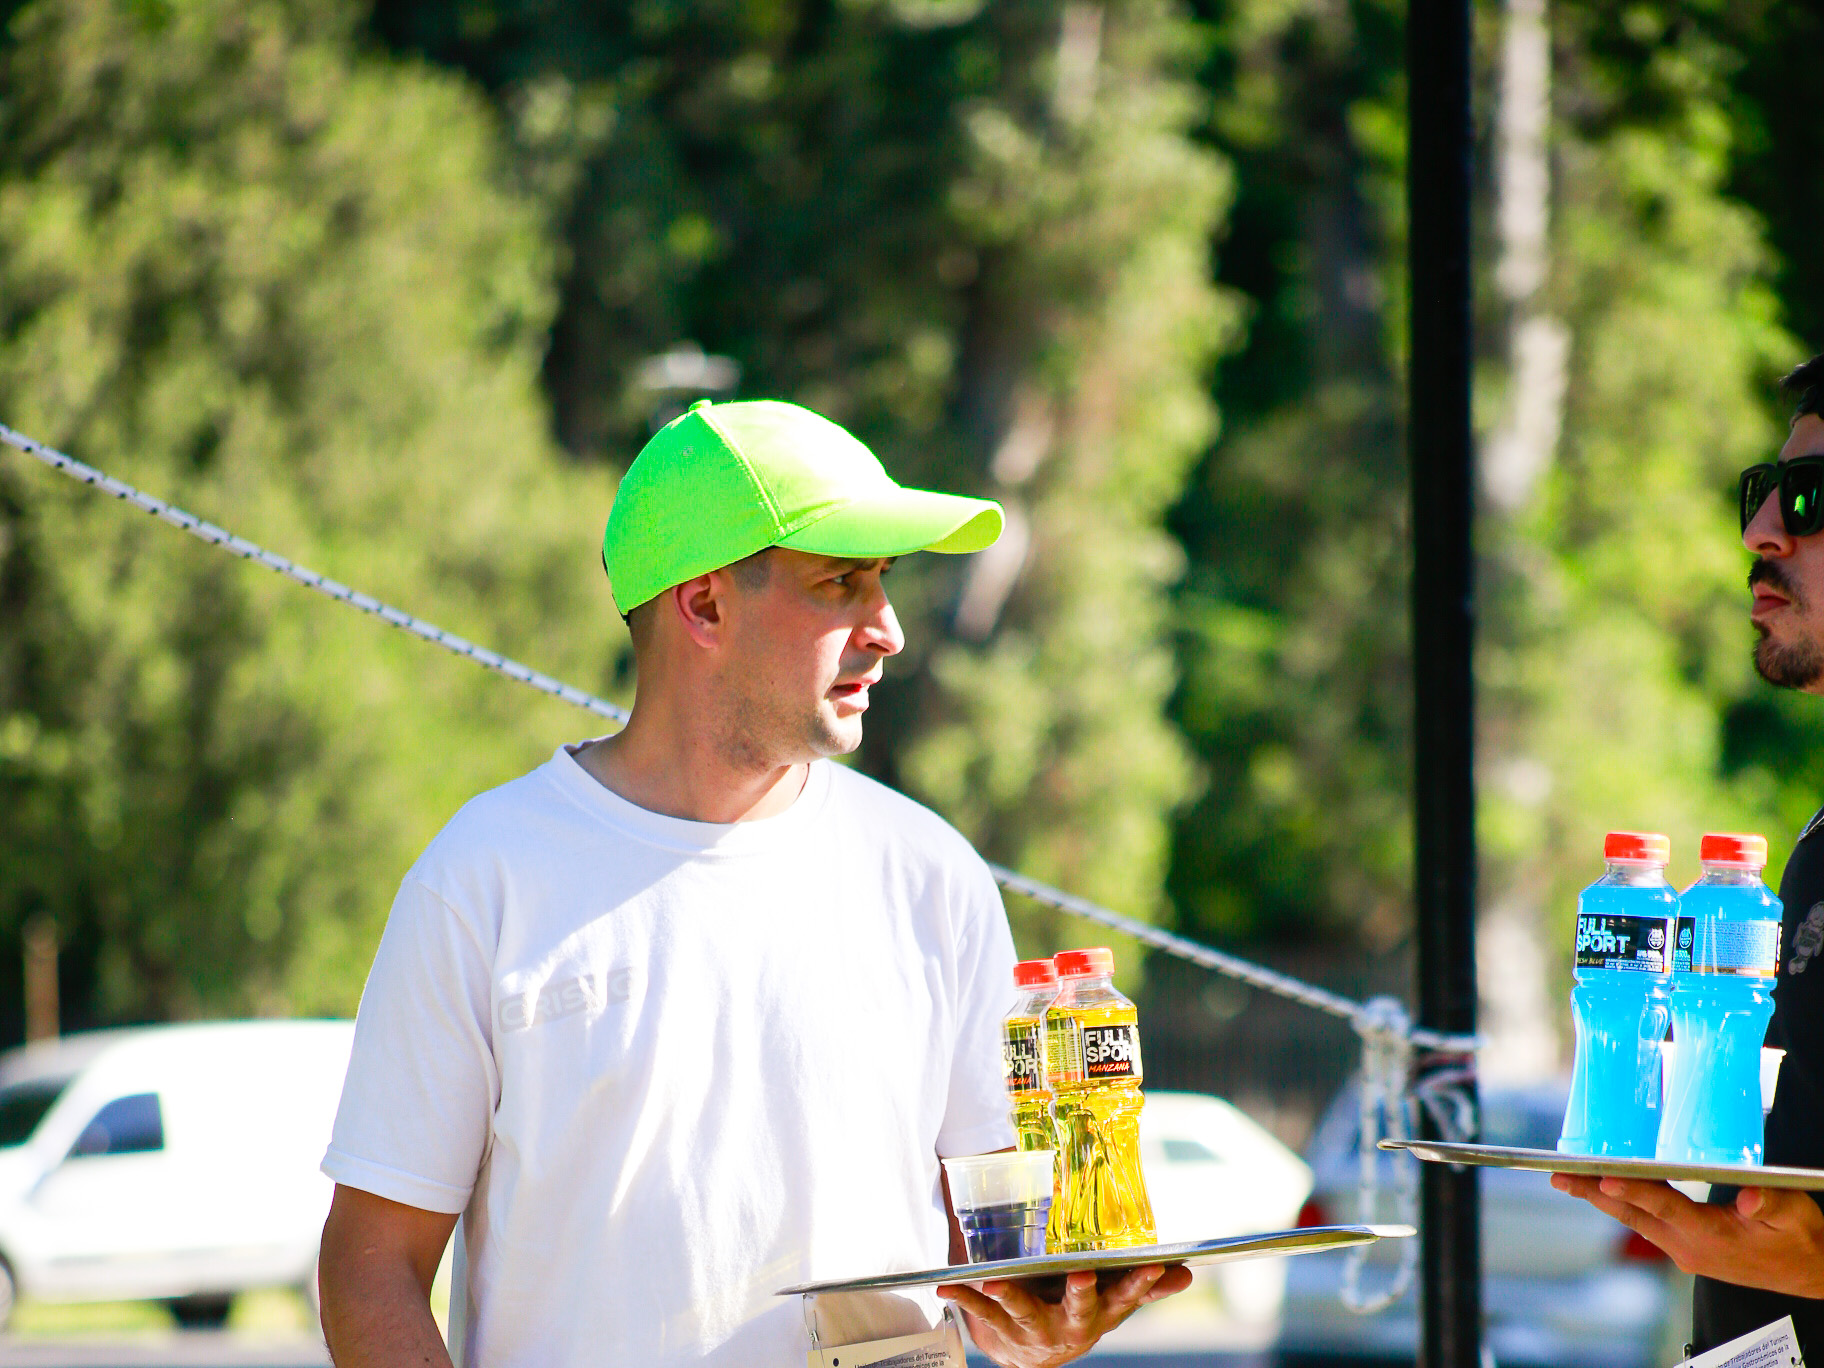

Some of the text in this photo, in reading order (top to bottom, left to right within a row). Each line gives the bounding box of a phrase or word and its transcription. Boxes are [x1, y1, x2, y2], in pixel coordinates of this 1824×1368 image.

[1579, 918, 1612, 935] FULL
[1577, 934, 1630, 953] SPORT
[1085, 1029, 1129, 1047] FULL
[1003, 1043, 1033, 1061] ULL
[1086, 1045, 1134, 1063] SPOR
[1088, 1062, 1131, 1073] MANZANA
[915, 1353, 924, 1361] del
[1731, 1347, 1761, 1364] Trabajadores
[1761, 1343, 1769, 1352] del
[1777, 1345, 1784, 1354] de
[931, 1360, 938, 1368] de
